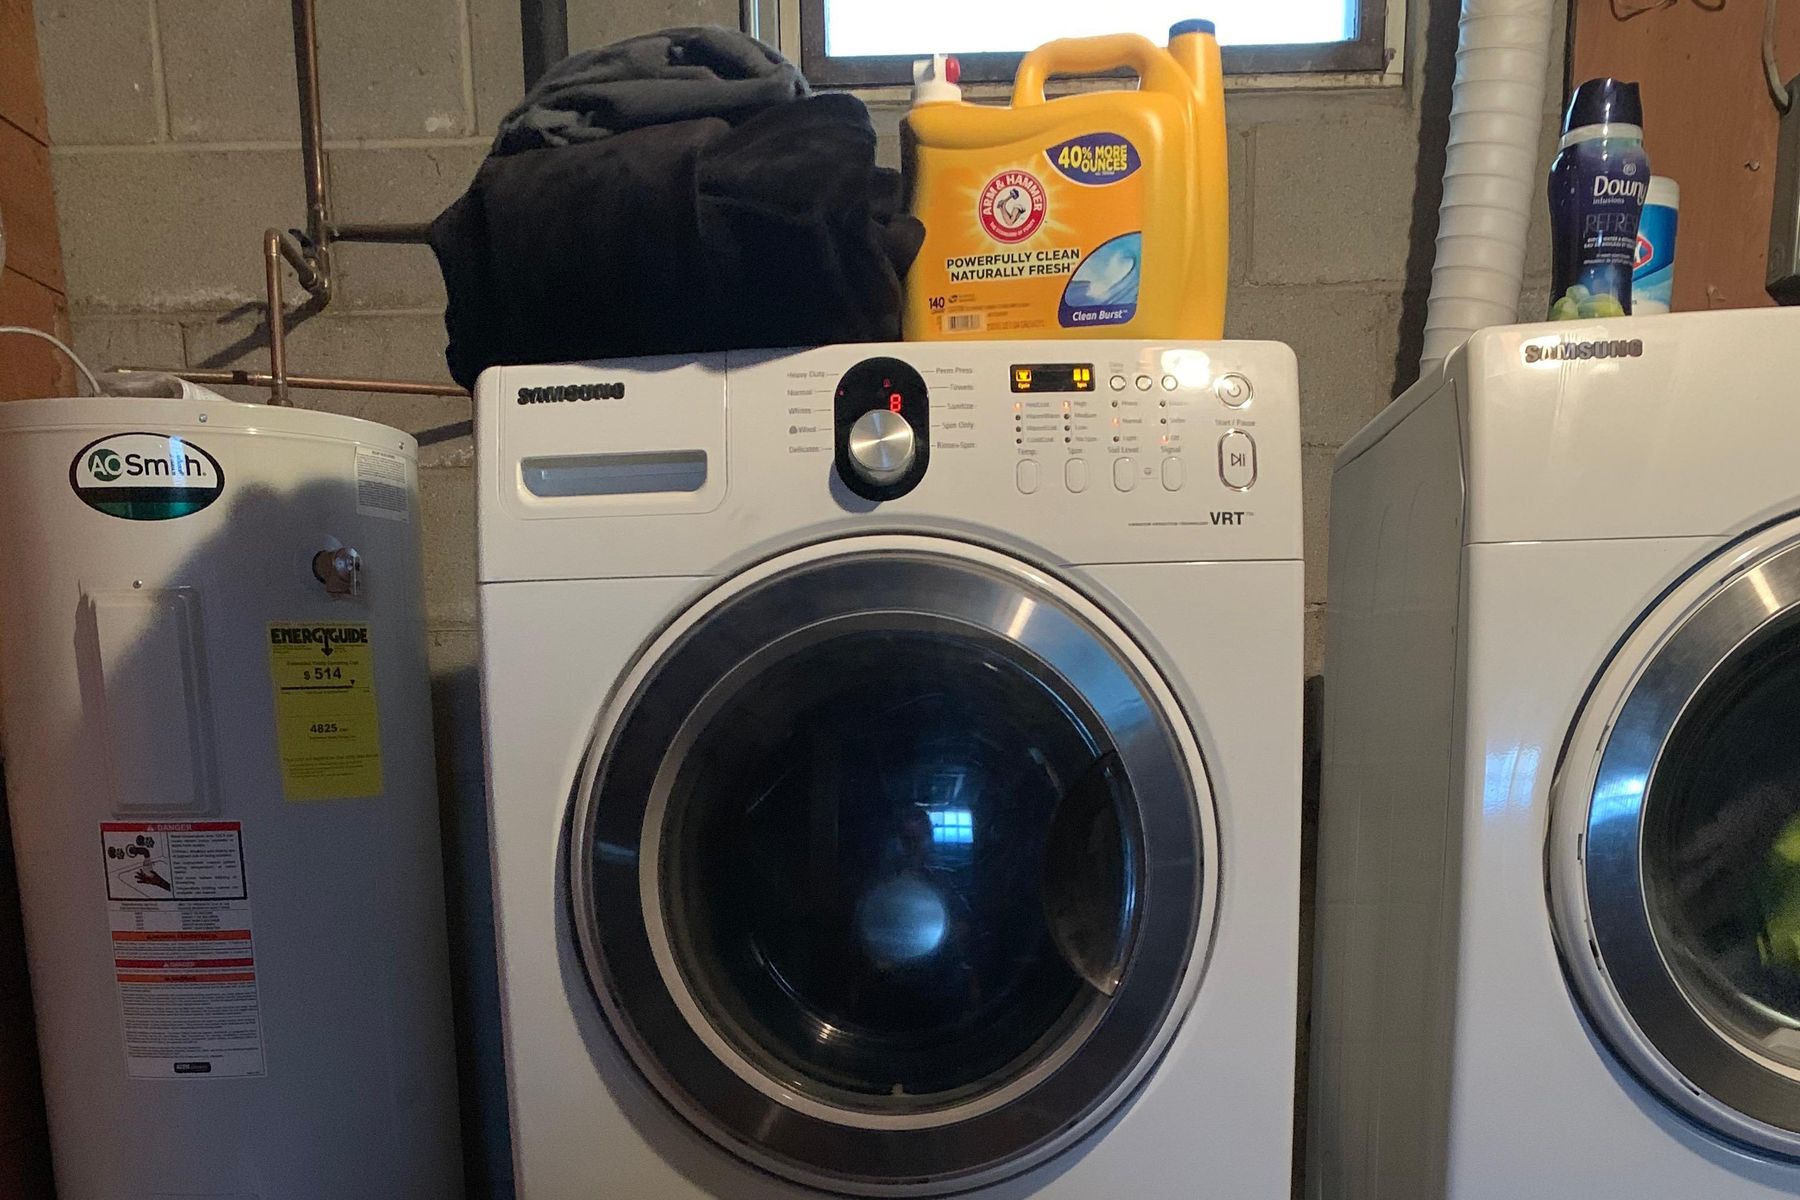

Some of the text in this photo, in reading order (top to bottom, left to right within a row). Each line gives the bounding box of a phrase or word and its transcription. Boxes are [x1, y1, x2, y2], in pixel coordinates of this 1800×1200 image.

[1058, 144, 1127, 168] 40% MORE
[1081, 158, 1127, 173] OUNCES
[982, 174, 1043, 216] ARM & HAMMER
[1593, 175, 1647, 206] Downy
[946, 248, 1080, 269] POWERFULLY CLEAN
[951, 262, 1071, 282] NATURALLY FRESH
[928, 297, 945, 310] 140
[1072, 311, 1097, 321] Clean
[1525, 339, 1643, 363] SAMSUNG
[517, 382, 625, 405] SAMSUNG
[314, 666, 342, 681] 514
[310, 723, 338, 734] 4825
[157, 824, 192, 832] DANGER
